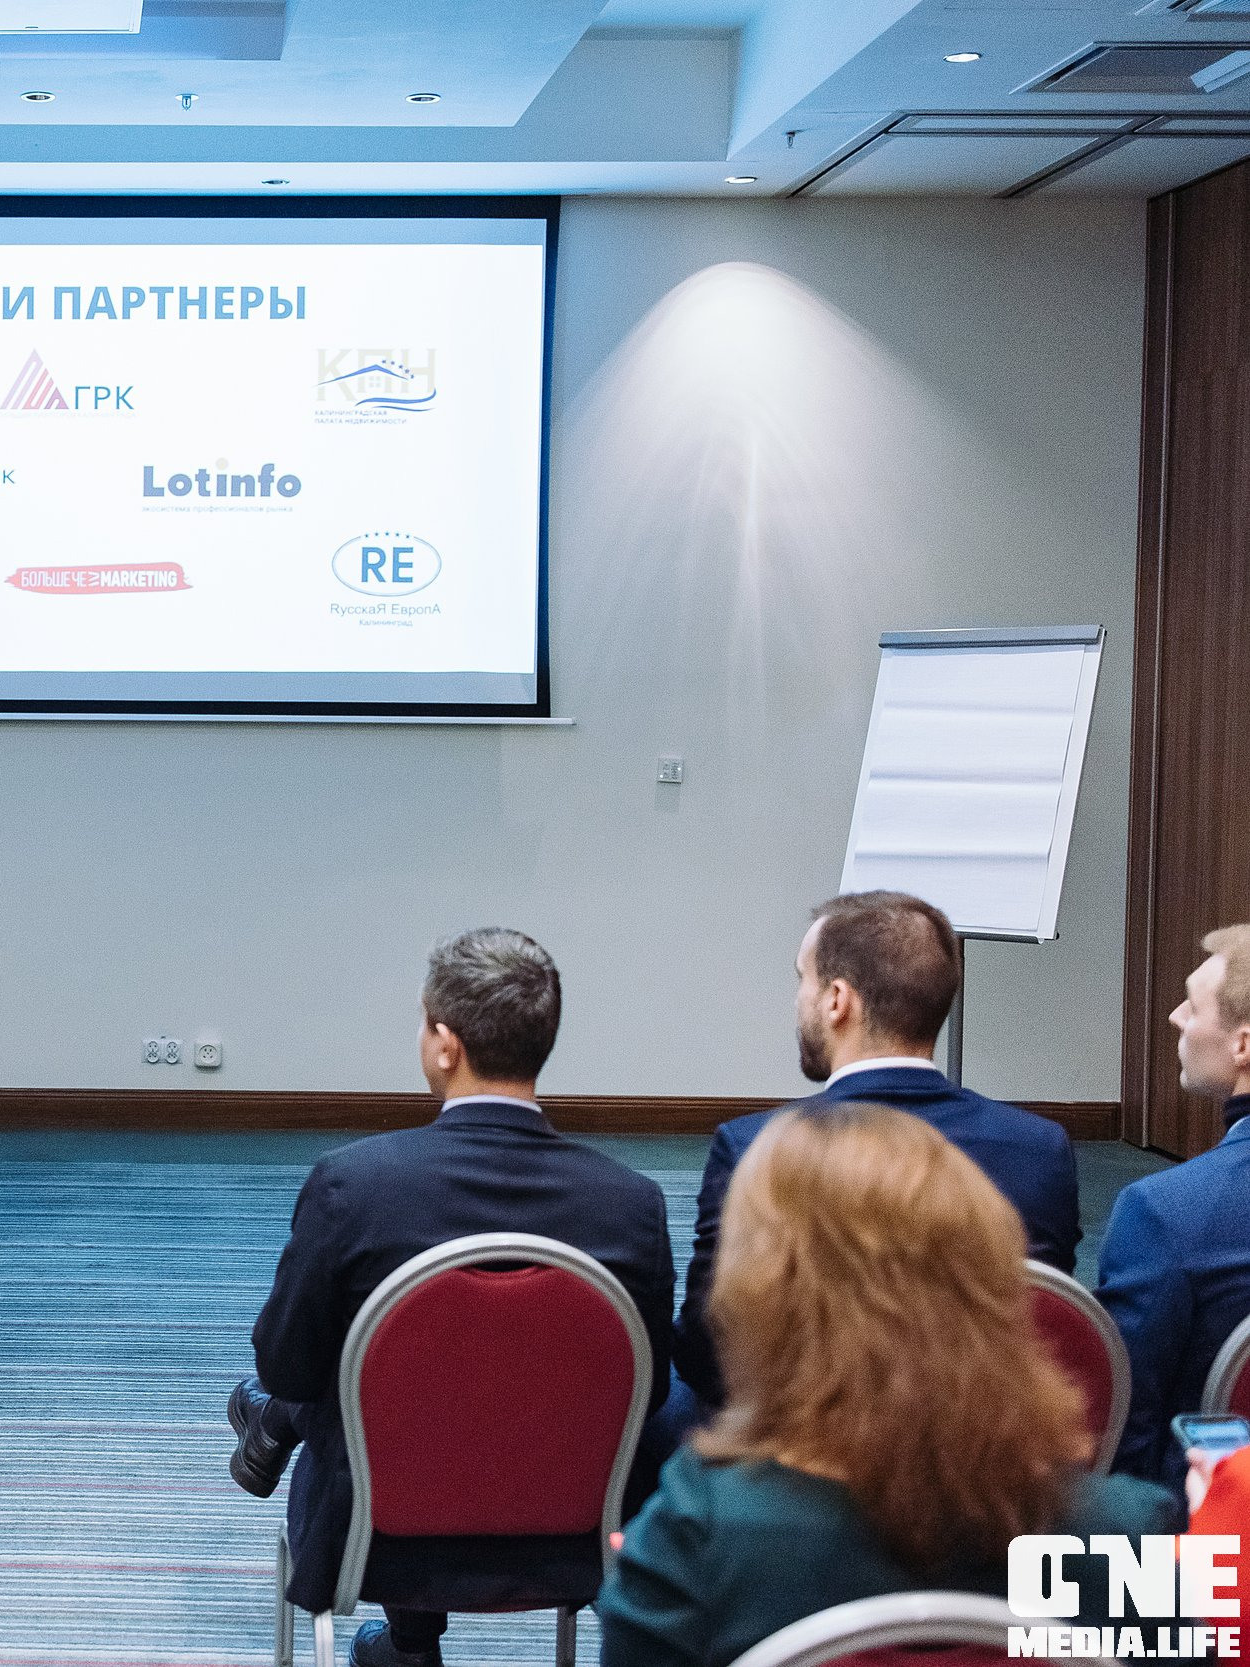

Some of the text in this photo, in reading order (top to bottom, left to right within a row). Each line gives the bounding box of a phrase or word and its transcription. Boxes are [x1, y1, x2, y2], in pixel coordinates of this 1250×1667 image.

[53, 286, 306, 320] ПАРТНЕРЫ
[75, 386, 134, 410] ГРК
[143, 457, 301, 498] Lotinfo
[21, 571, 71, 587] БОЛЬШЕ
[100, 570, 178, 587] MARKETING
[361, 546, 414, 583] RE
